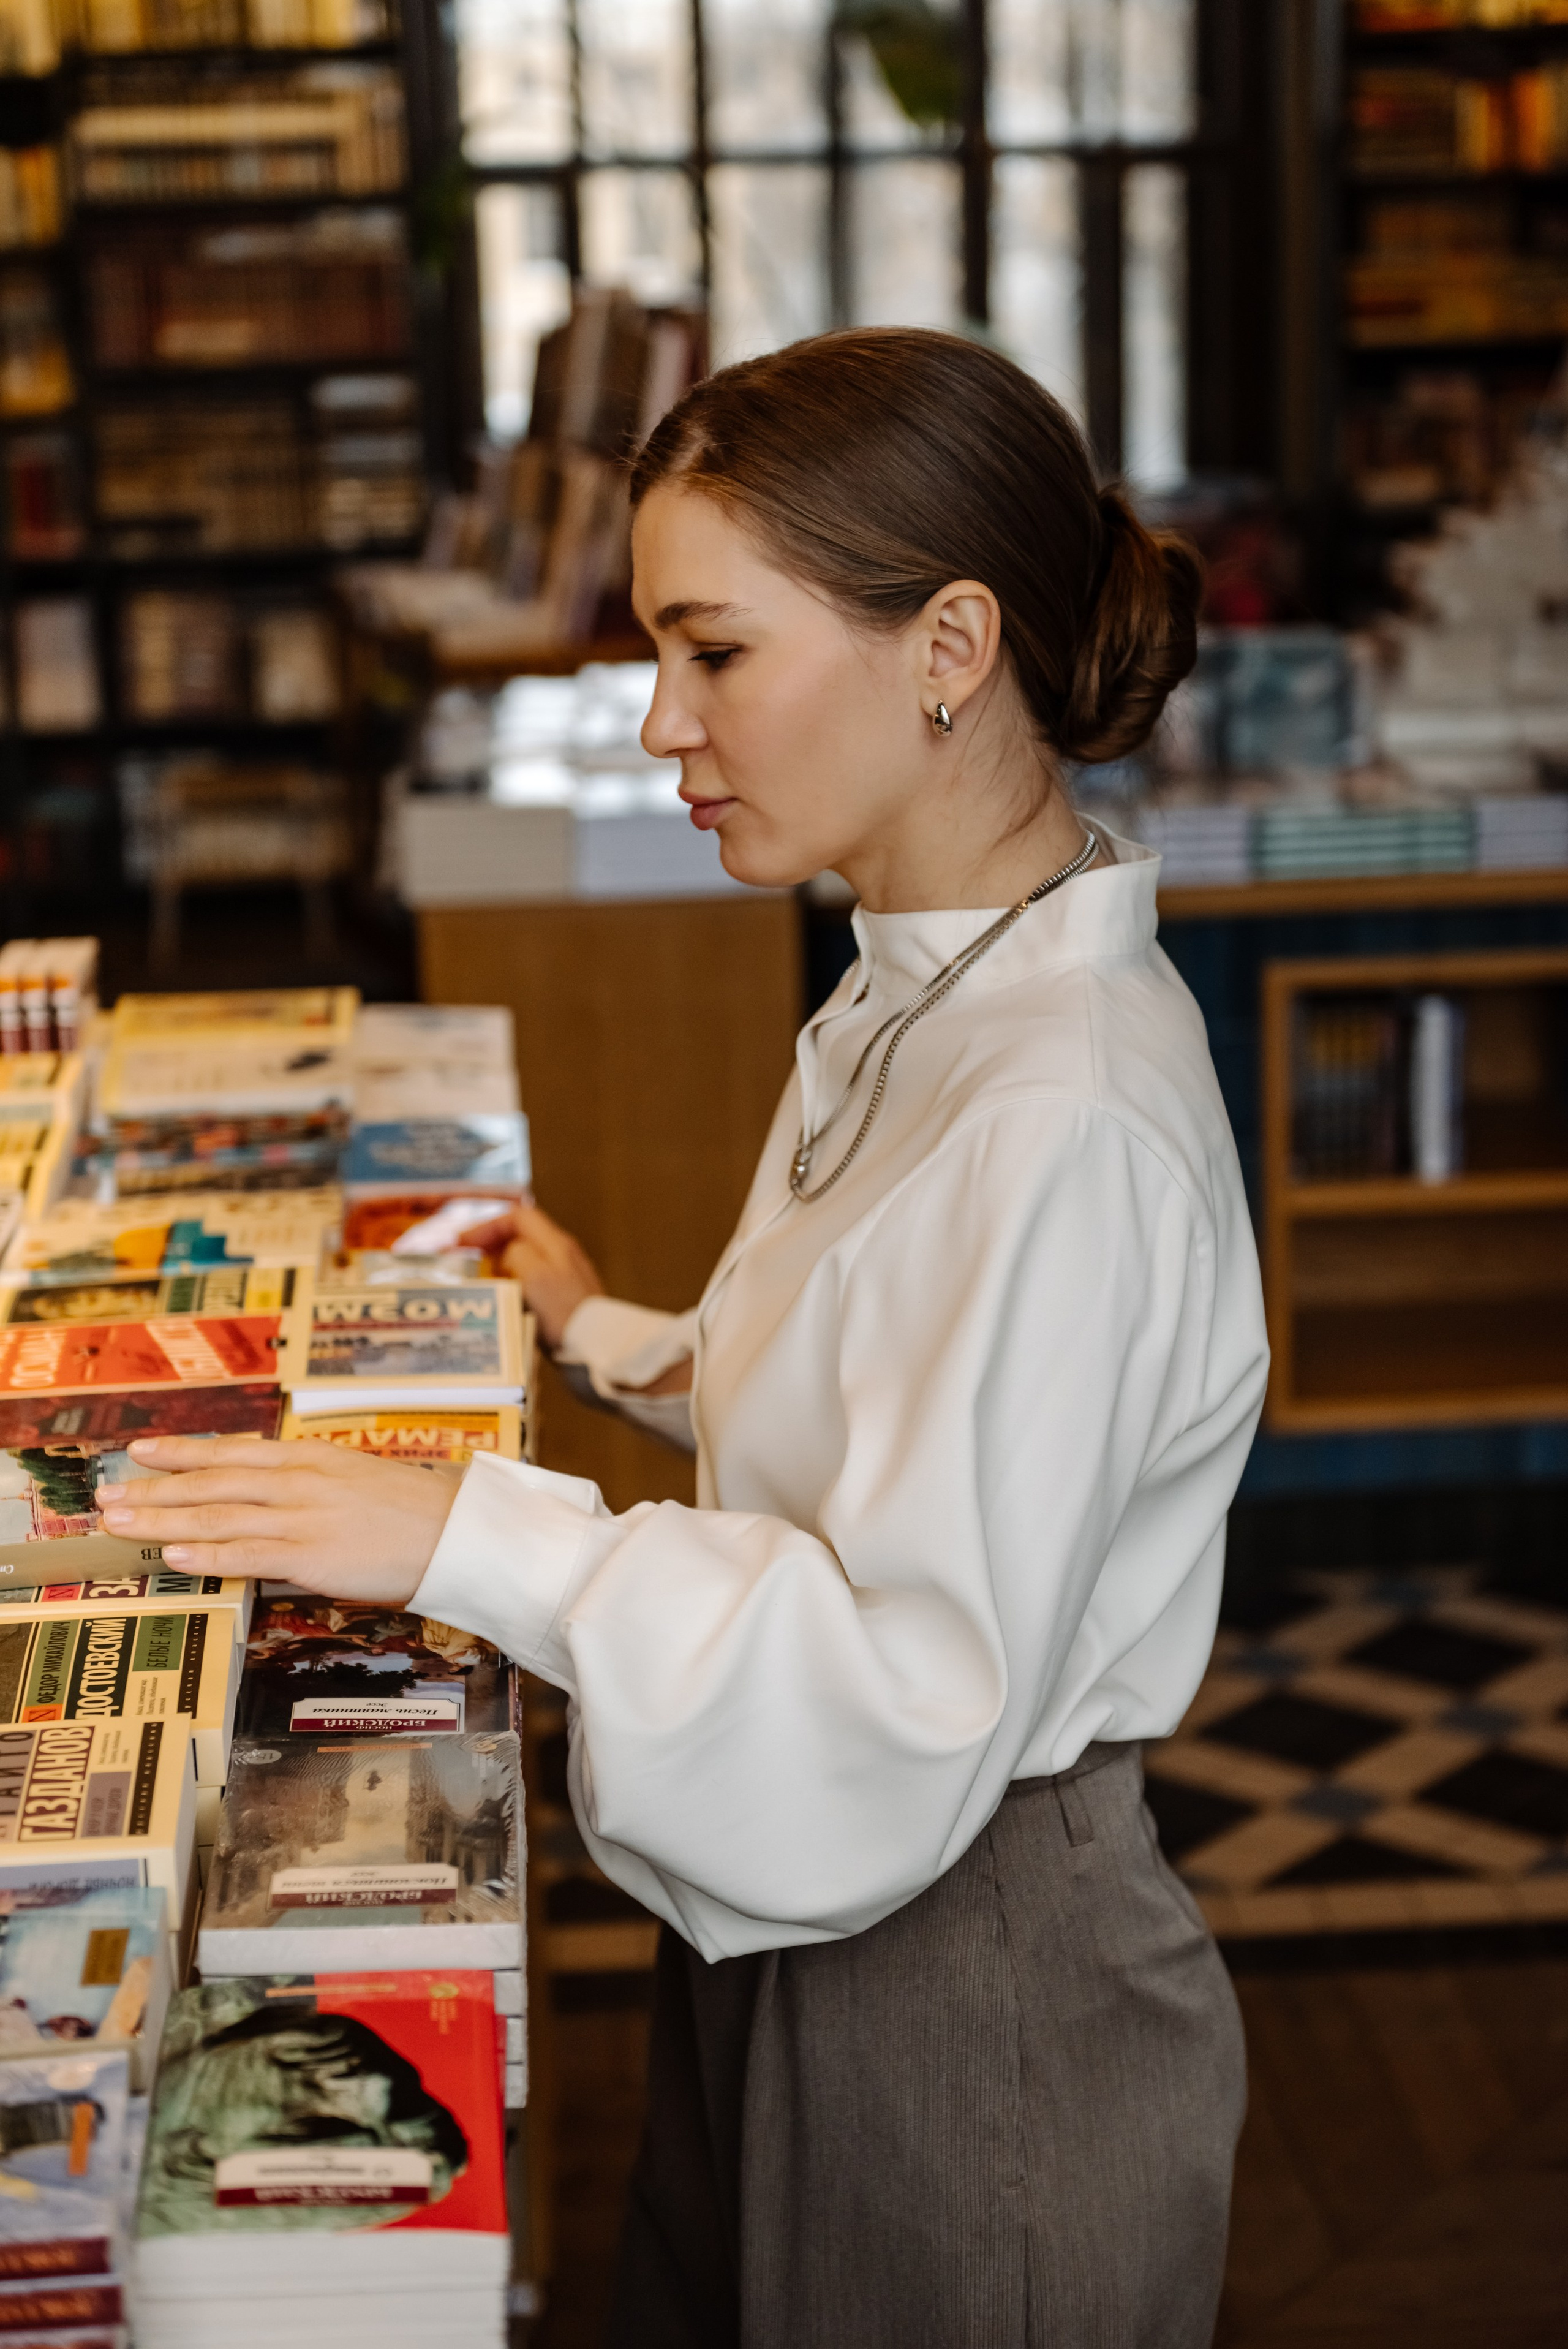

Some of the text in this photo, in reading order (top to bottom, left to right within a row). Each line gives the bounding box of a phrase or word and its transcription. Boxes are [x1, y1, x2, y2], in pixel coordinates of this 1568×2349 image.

[141, 1547, 163, 1560] ЕВ
[36, 1621, 71, 1704] ФЕДОР МИХАЙЛОВИЧ
[75, 1618, 126, 1720] ДОСТОЕВСКИЙ
[146, 1617, 175, 1668] БЕЛЫЕ НОЧИ
[20, 1727, 92, 1841] ГАЗДАНОВ
